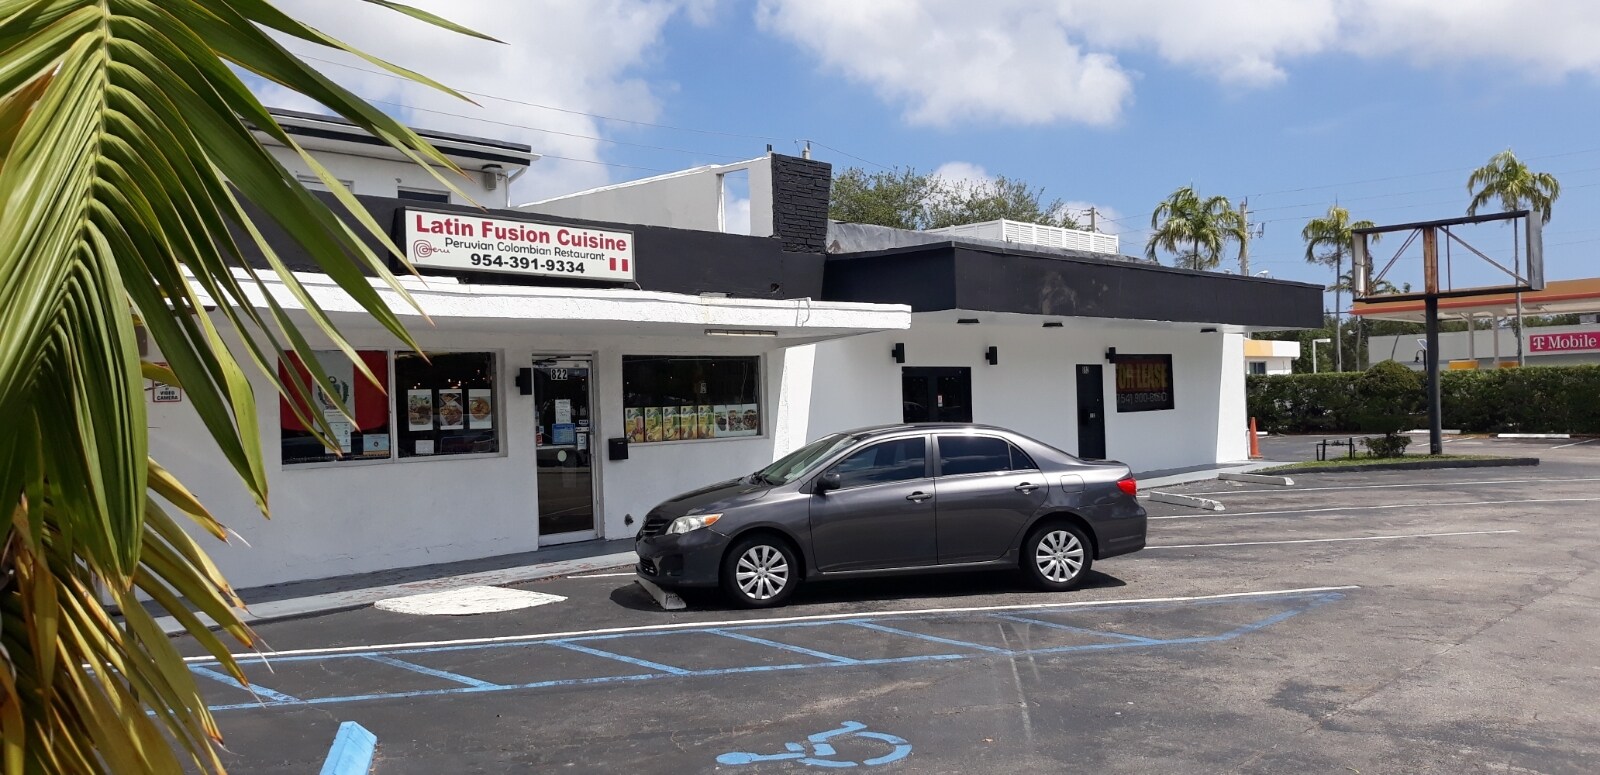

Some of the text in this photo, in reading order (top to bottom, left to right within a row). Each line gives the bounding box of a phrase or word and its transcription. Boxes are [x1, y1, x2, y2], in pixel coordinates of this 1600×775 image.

[416, 214, 627, 252] Latin Fusion Cuisine
[445, 238, 605, 261] Peruvian Colombian Restaurant
[470, 253, 585, 274] 954-391-9334
[1548, 334, 1597, 349] Mobile
[551, 369, 567, 380] 822
[1116, 363, 1168, 389] OR LEASE
